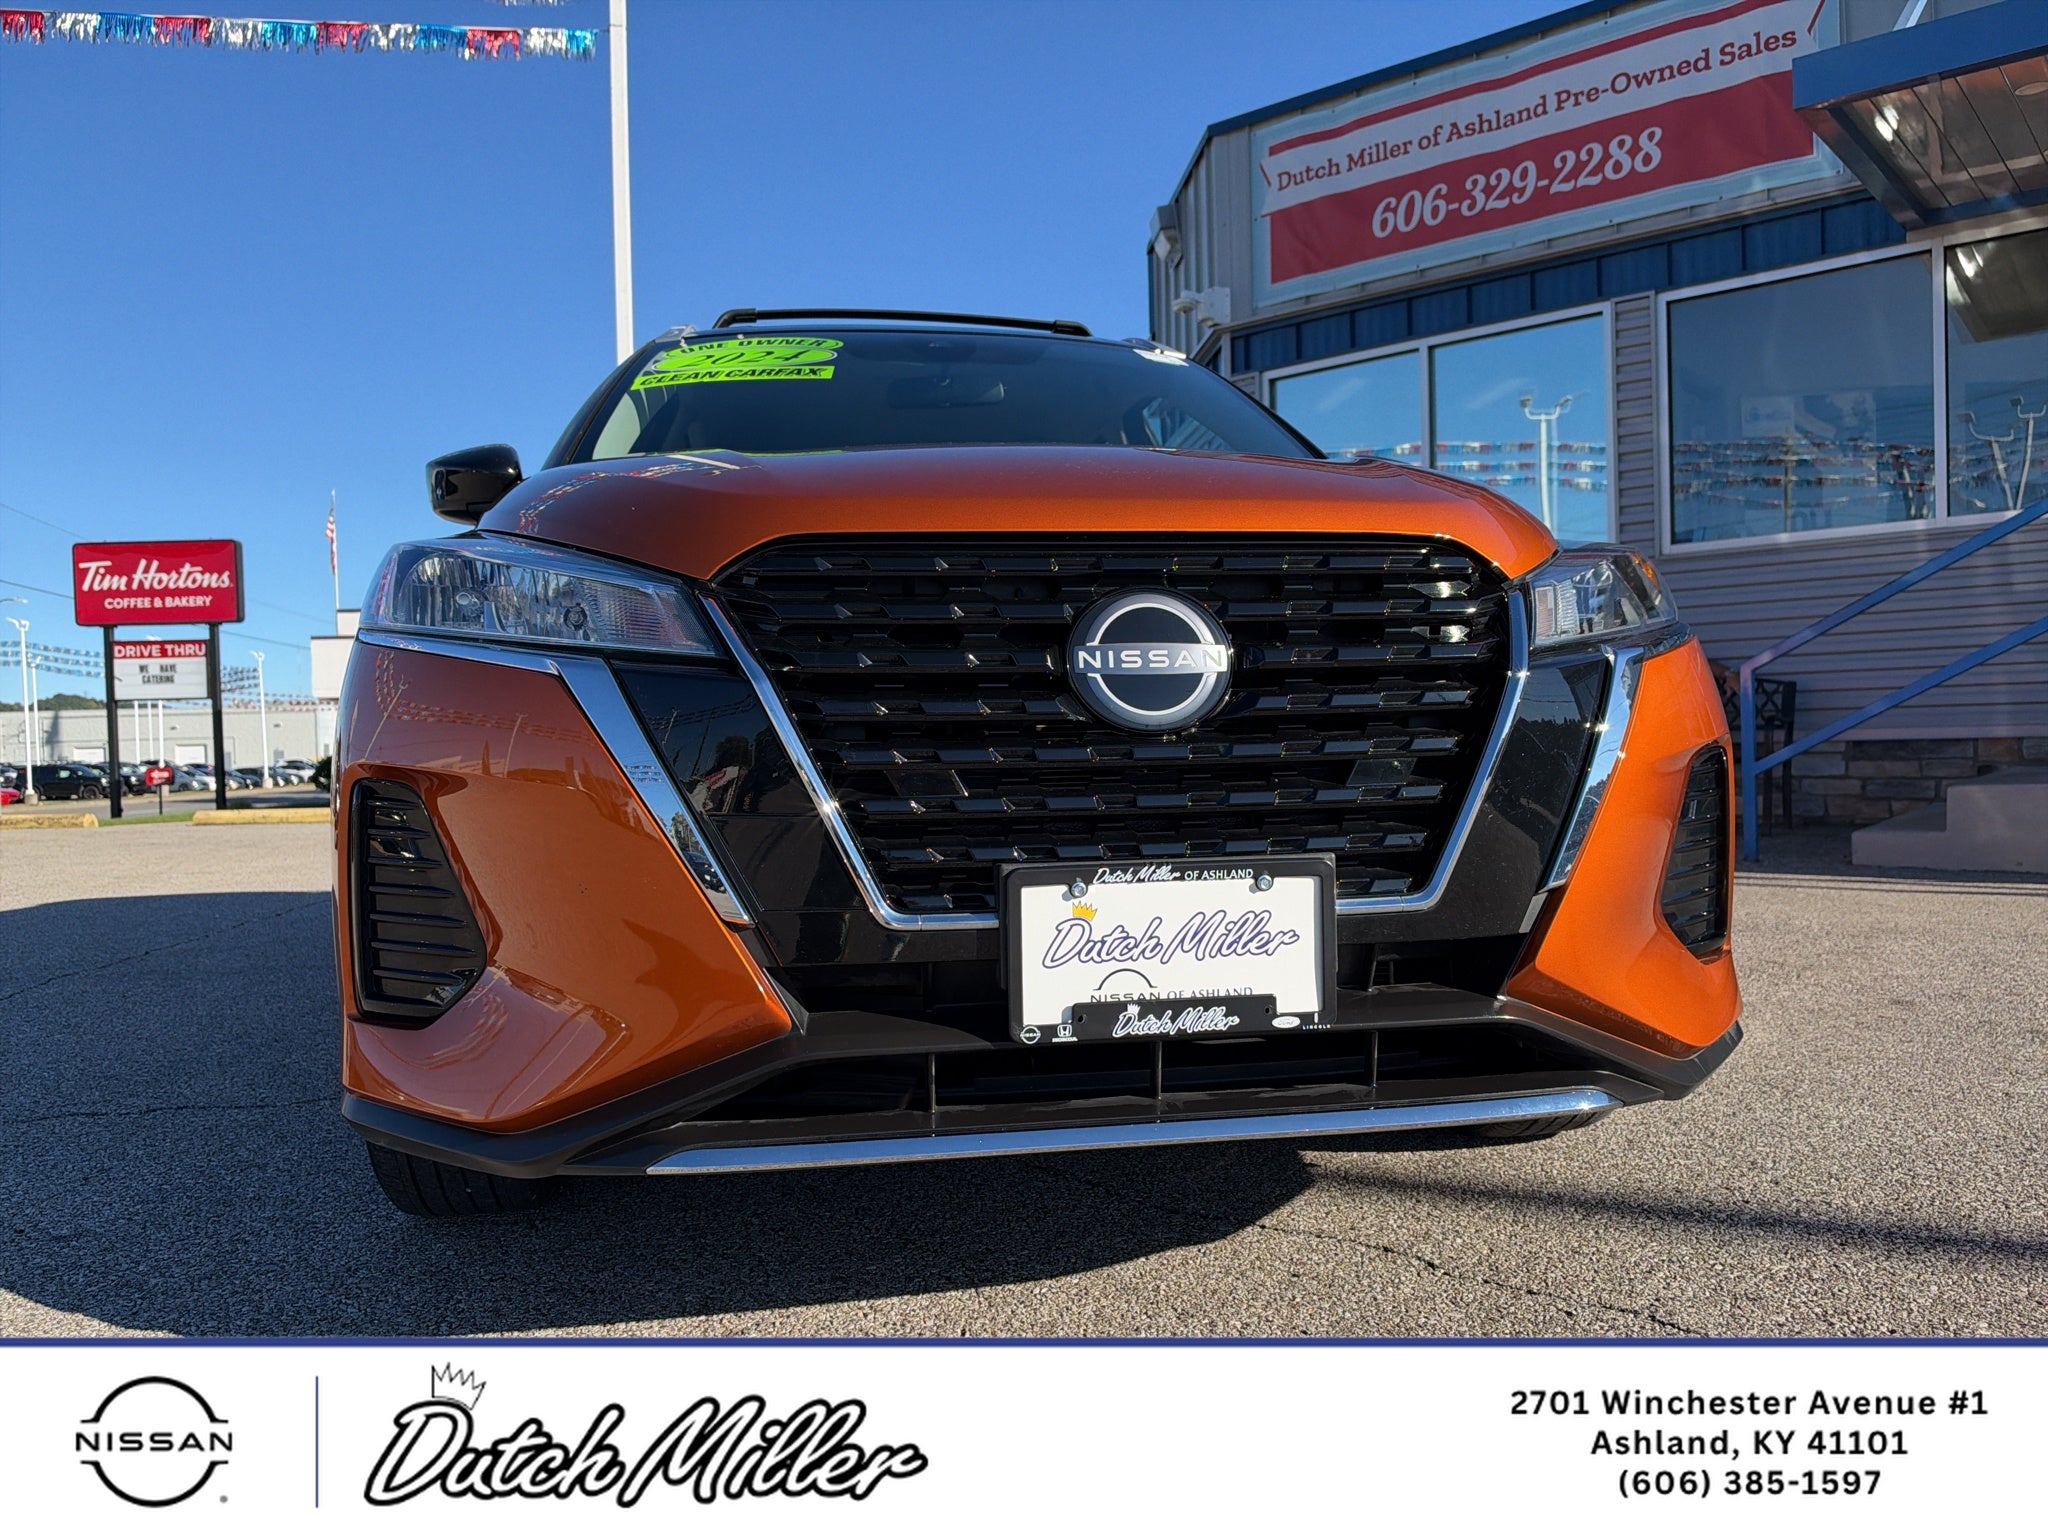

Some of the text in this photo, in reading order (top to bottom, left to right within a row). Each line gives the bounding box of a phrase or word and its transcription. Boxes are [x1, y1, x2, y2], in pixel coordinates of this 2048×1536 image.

[1277, 29, 1797, 191] Dutch Miller of Ashland Pre-Owned Sales
[1372, 126, 1662, 239] 606-329-2288
[738, 338, 830, 347] OWNER
[679, 349, 813, 367] 2024
[639, 367, 823, 386] CLEAN CARFAX
[78, 558, 231, 592] Tim Hortons
[104, 595, 213, 609] COFFEE & BAKERY
[114, 643, 206, 657] DRIVE THRU
[1077, 649, 1223, 669] NISSAN
[138, 664, 177, 673] WE HAVE
[142, 675, 175, 684] CATERING
[1093, 863, 1254, 884] Dutch Miller OF ASHLAND
[1042, 909, 1300, 969] Dutch Miller
[1090, 992, 1160, 1003] NISSAN
[1112, 1006, 1241, 1038] Dutch Miller
